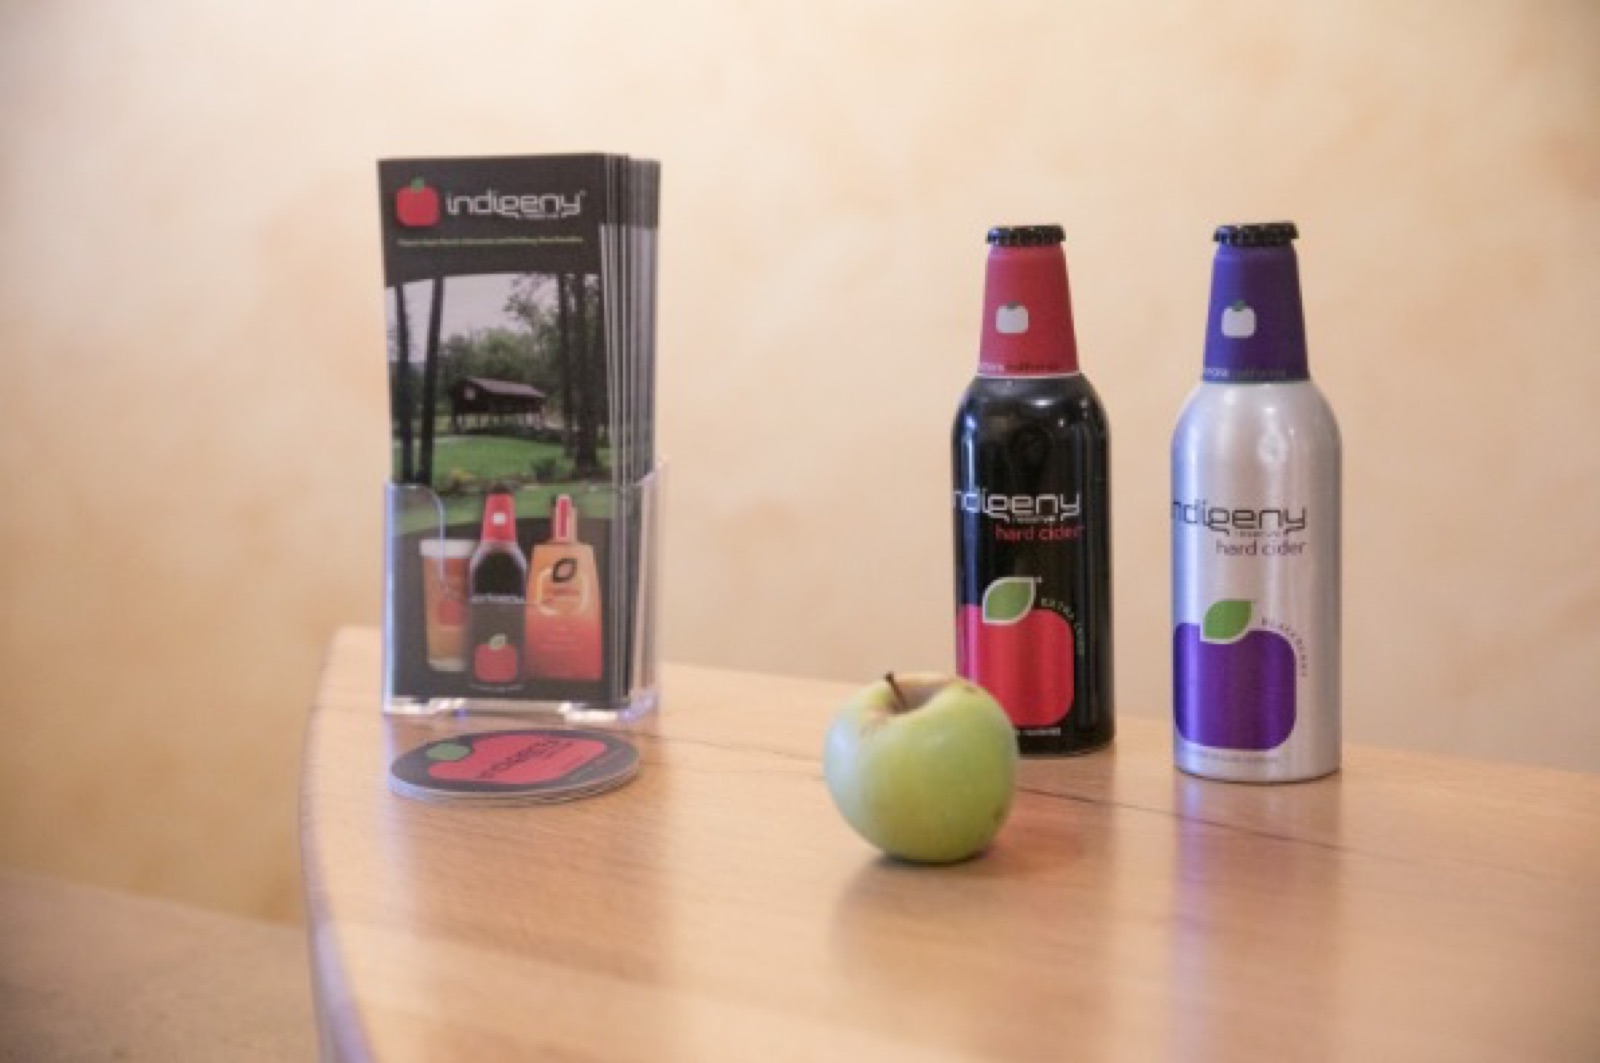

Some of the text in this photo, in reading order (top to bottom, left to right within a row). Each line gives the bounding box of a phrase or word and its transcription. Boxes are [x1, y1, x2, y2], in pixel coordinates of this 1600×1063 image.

[995, 523, 1083, 541] hard cider
[1216, 539, 1304, 557] hard cider
